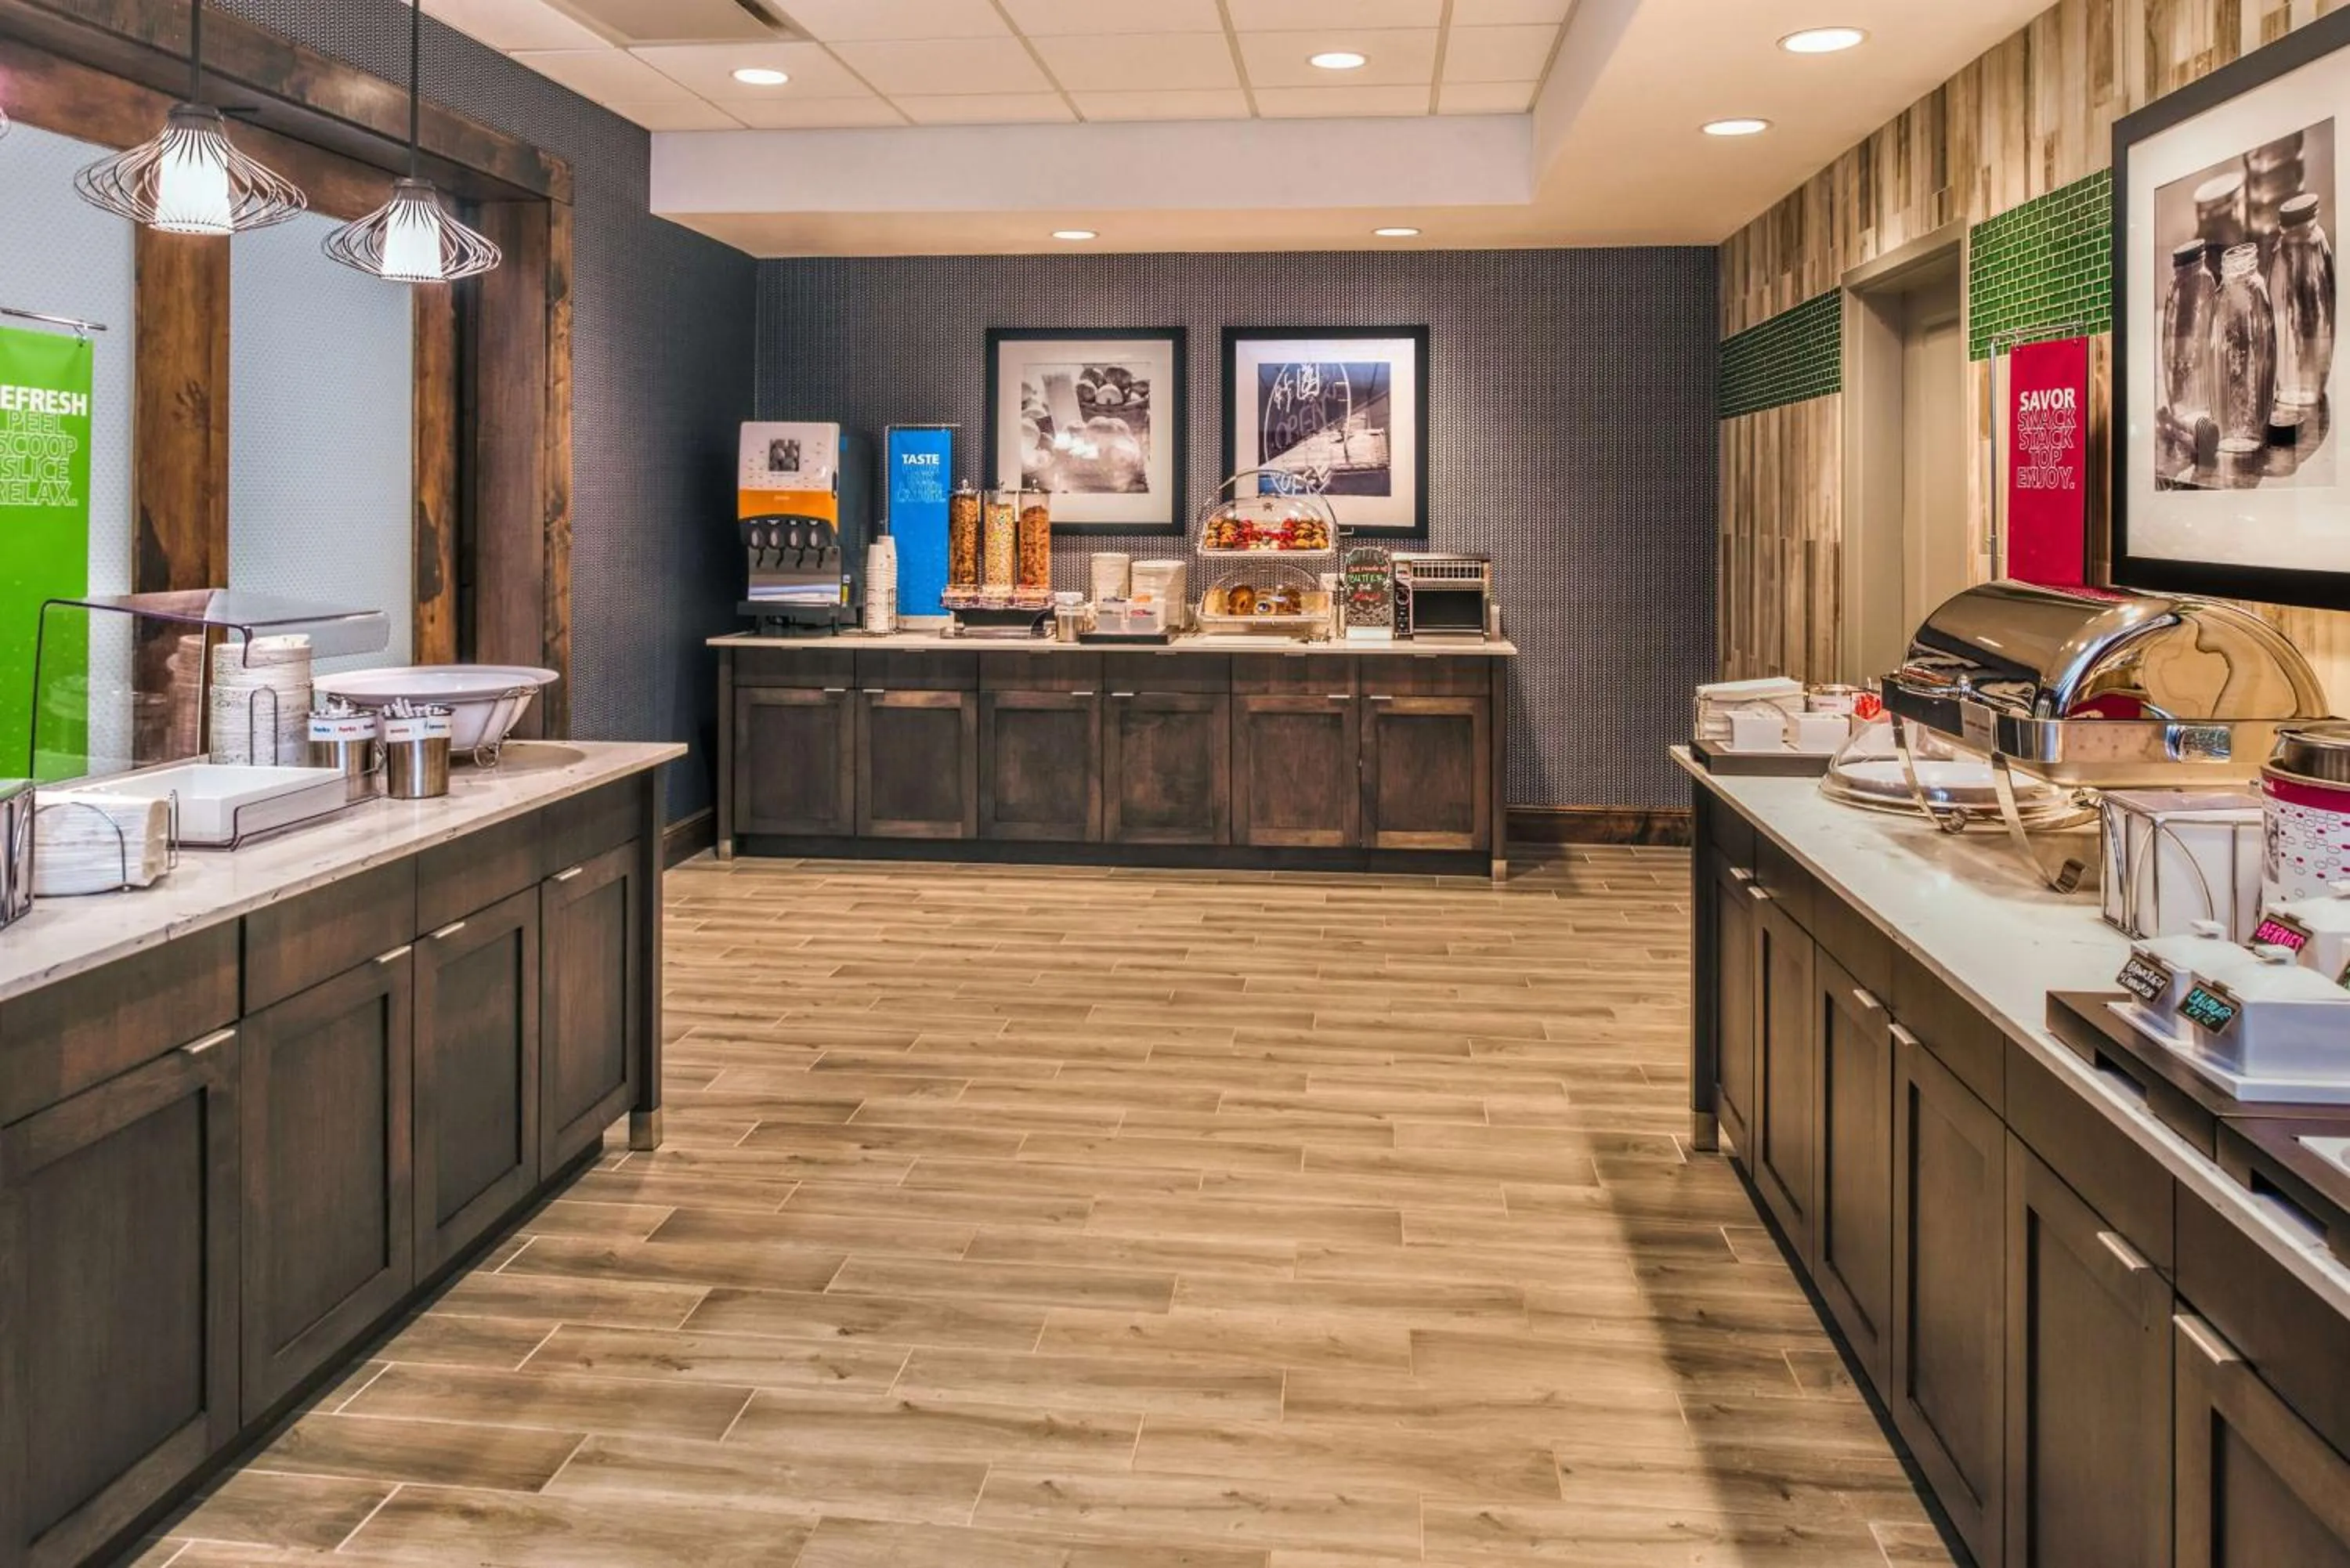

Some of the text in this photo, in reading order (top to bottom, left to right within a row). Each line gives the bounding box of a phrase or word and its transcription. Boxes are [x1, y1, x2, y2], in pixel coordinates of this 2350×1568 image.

[2019, 388, 2075, 410] SAVOR
[7, 410, 67, 435] PEEL
[2017, 407, 2077, 430] SNACK
[2019, 428, 2074, 450] STACK
[1, 456, 70, 482] SLICE
[902, 453, 941, 465] TASTE
[2028, 446, 2062, 469] TOP
[2016, 466, 2075, 490] ENJOY.
